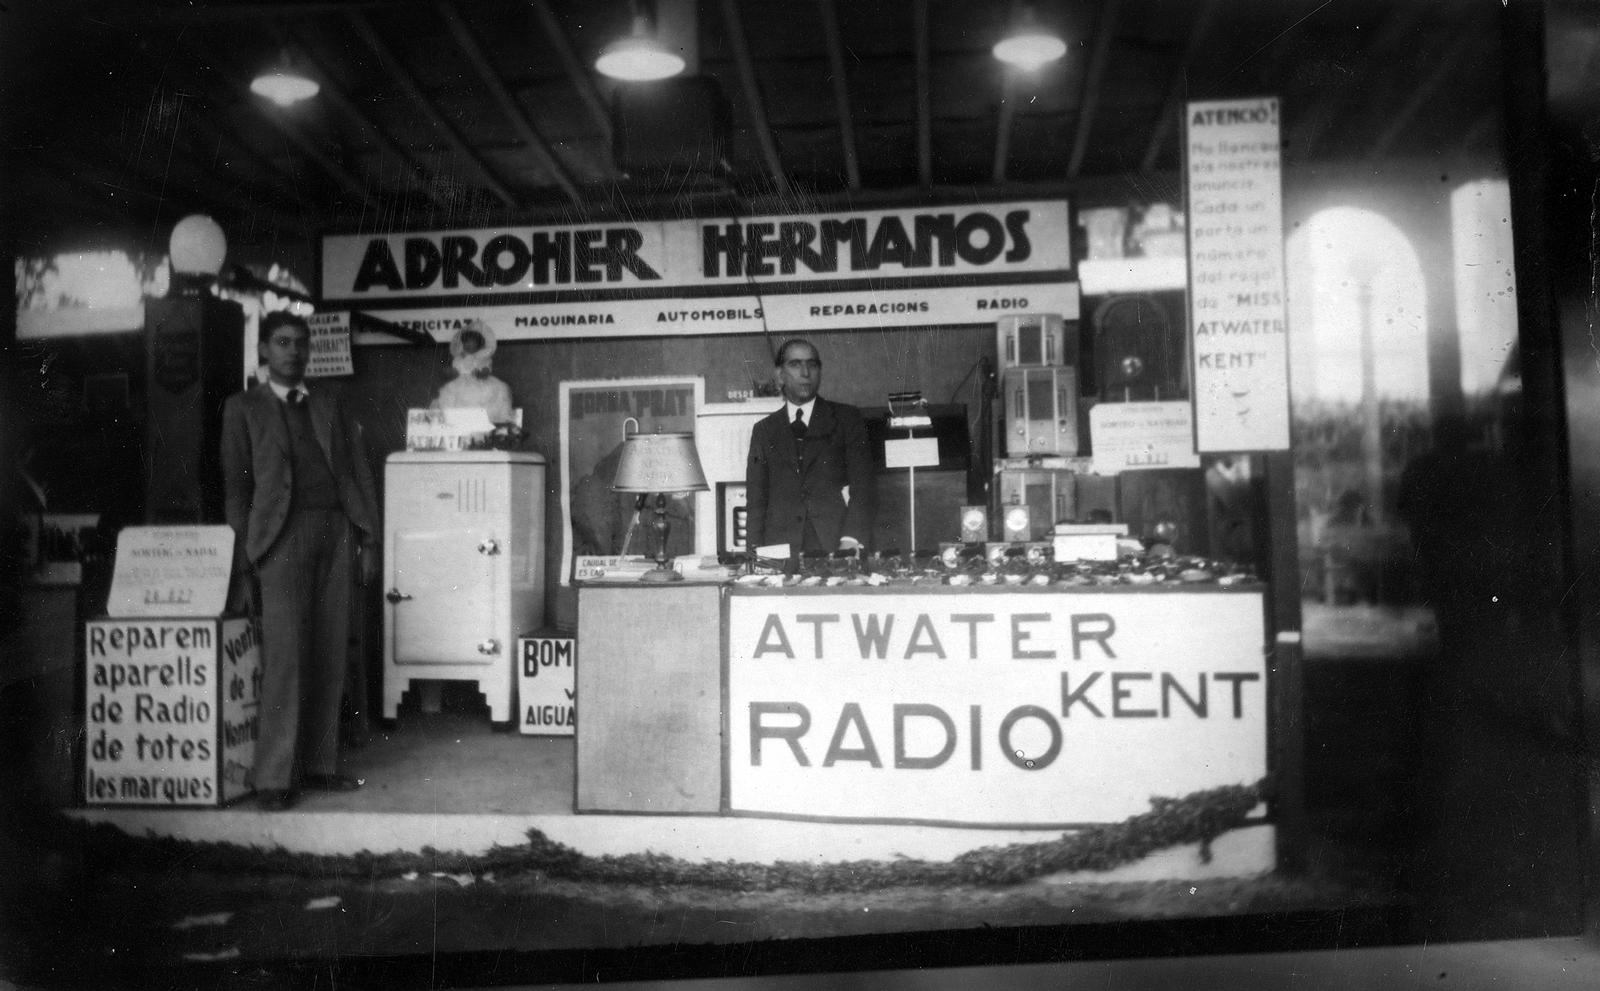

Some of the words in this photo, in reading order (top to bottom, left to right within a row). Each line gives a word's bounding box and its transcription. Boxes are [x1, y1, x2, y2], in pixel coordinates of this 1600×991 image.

[352, 228, 663, 292] ADROHER
[702, 209, 1032, 278] HERMANOS
[514, 313, 615, 328] MAQUINARIA
[656, 308, 764, 323] AUTOMOBILS
[809, 301, 930, 317] REPARACIONS
[976, 297, 1029, 311] RADIO
[1196, 319, 1286, 336] ATWATER
[90, 626, 211, 657] Reparem
[752, 611, 1118, 661] ATWATER
[93, 655, 207, 694] aparells
[91, 693, 123, 723] de
[136, 693, 211, 723] Radio
[1060, 670, 1261, 719] KENT
[92, 729, 124, 761] de
[135, 732, 211, 761] totes
[748, 701, 1064, 772] RADIO
[89, 768, 117, 799] les
[120, 776, 213, 803] marques
